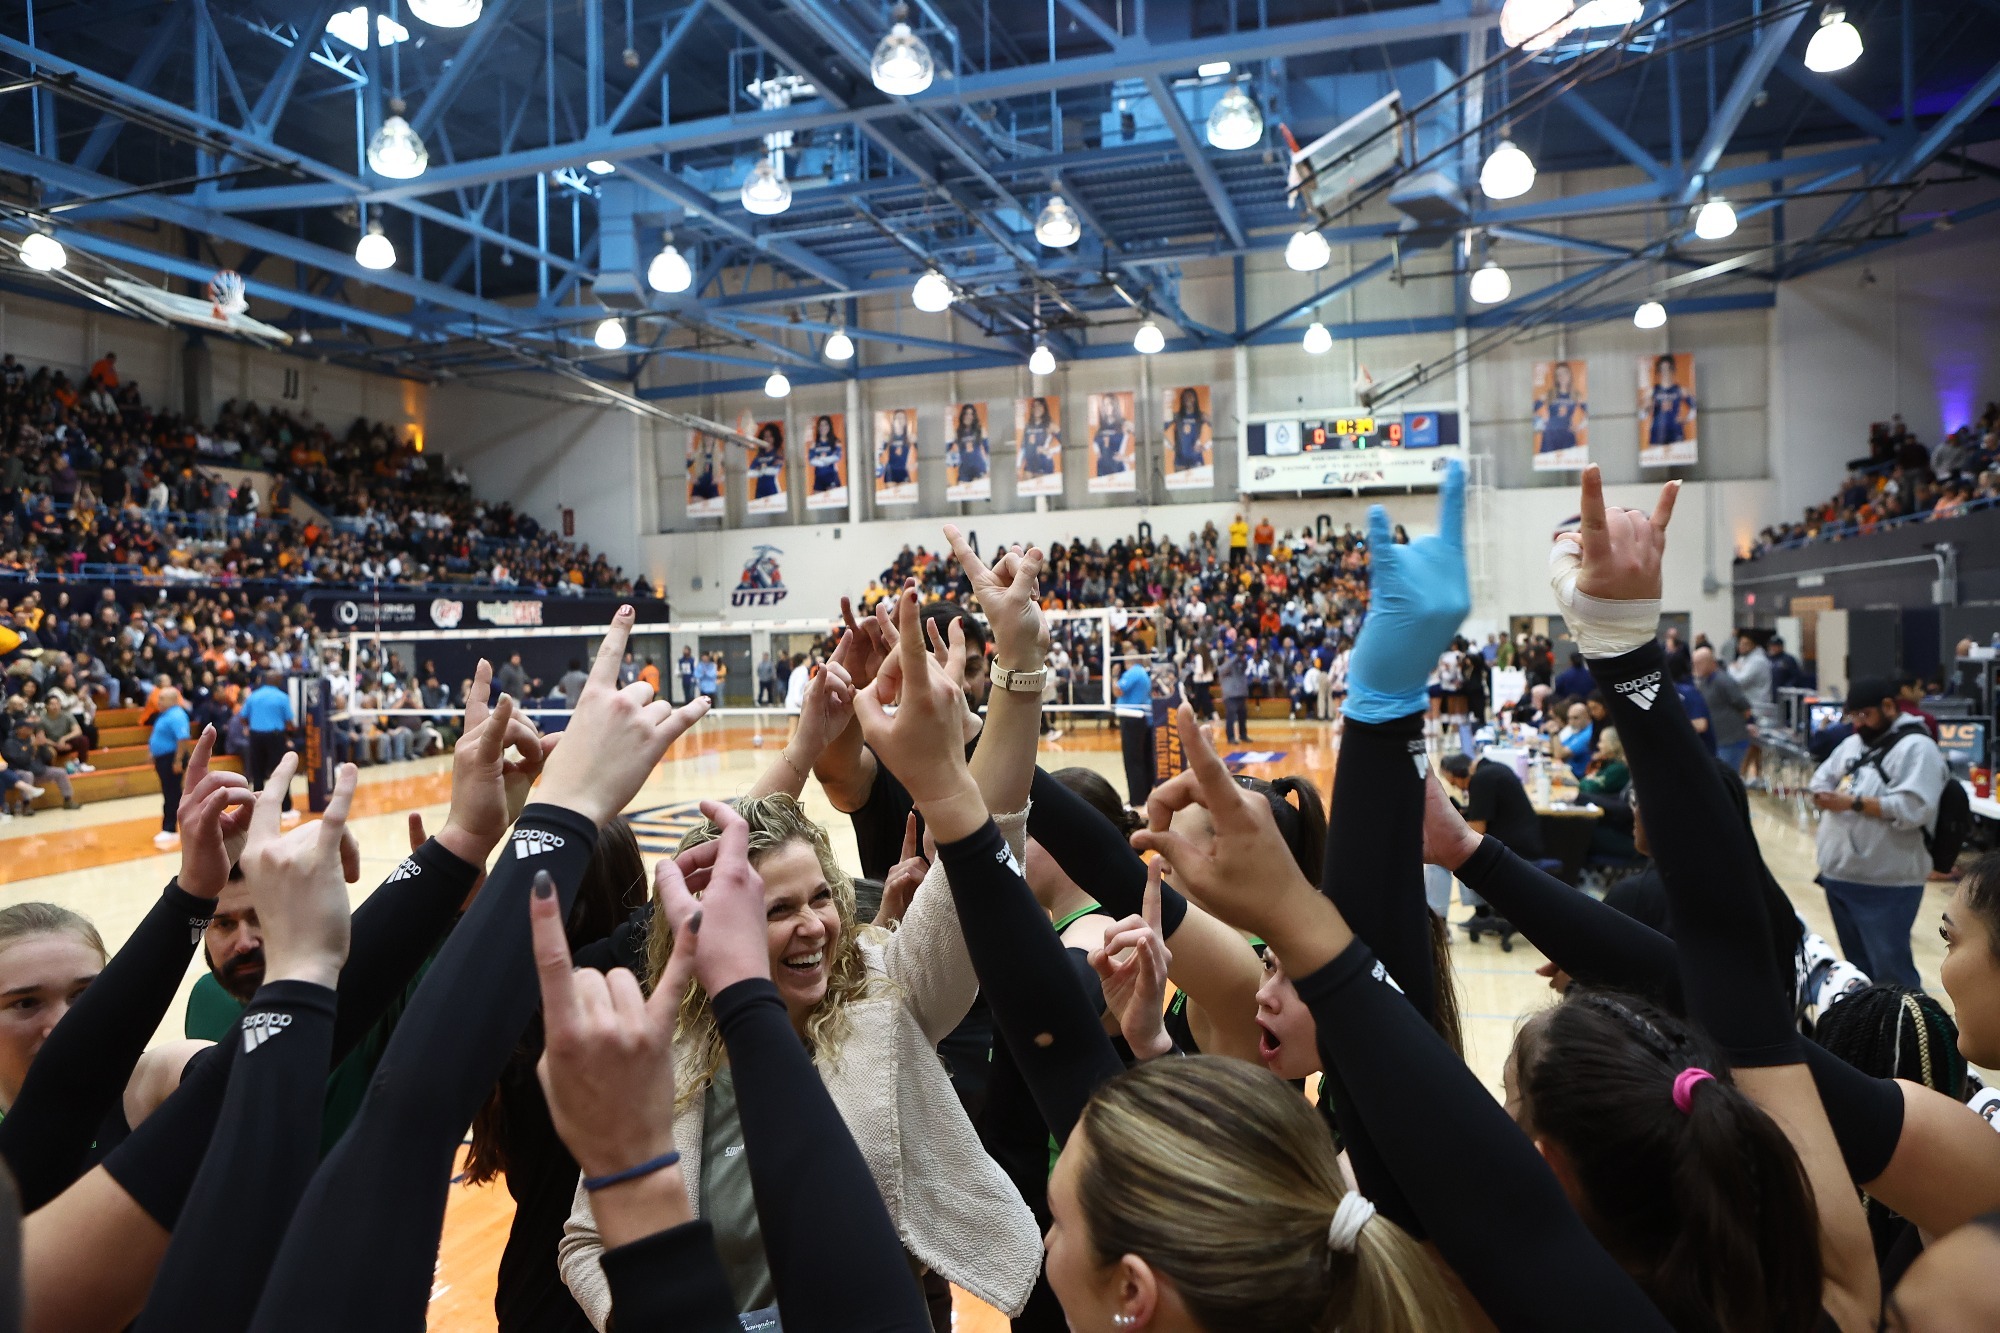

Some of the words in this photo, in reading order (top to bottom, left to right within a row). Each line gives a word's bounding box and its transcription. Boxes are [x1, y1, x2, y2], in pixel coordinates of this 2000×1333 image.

[731, 590, 788, 607] UTEP
[1613, 670, 1662, 693] adidas
[511, 829, 566, 848] adidas
[241, 1012, 293, 1030] adidas
